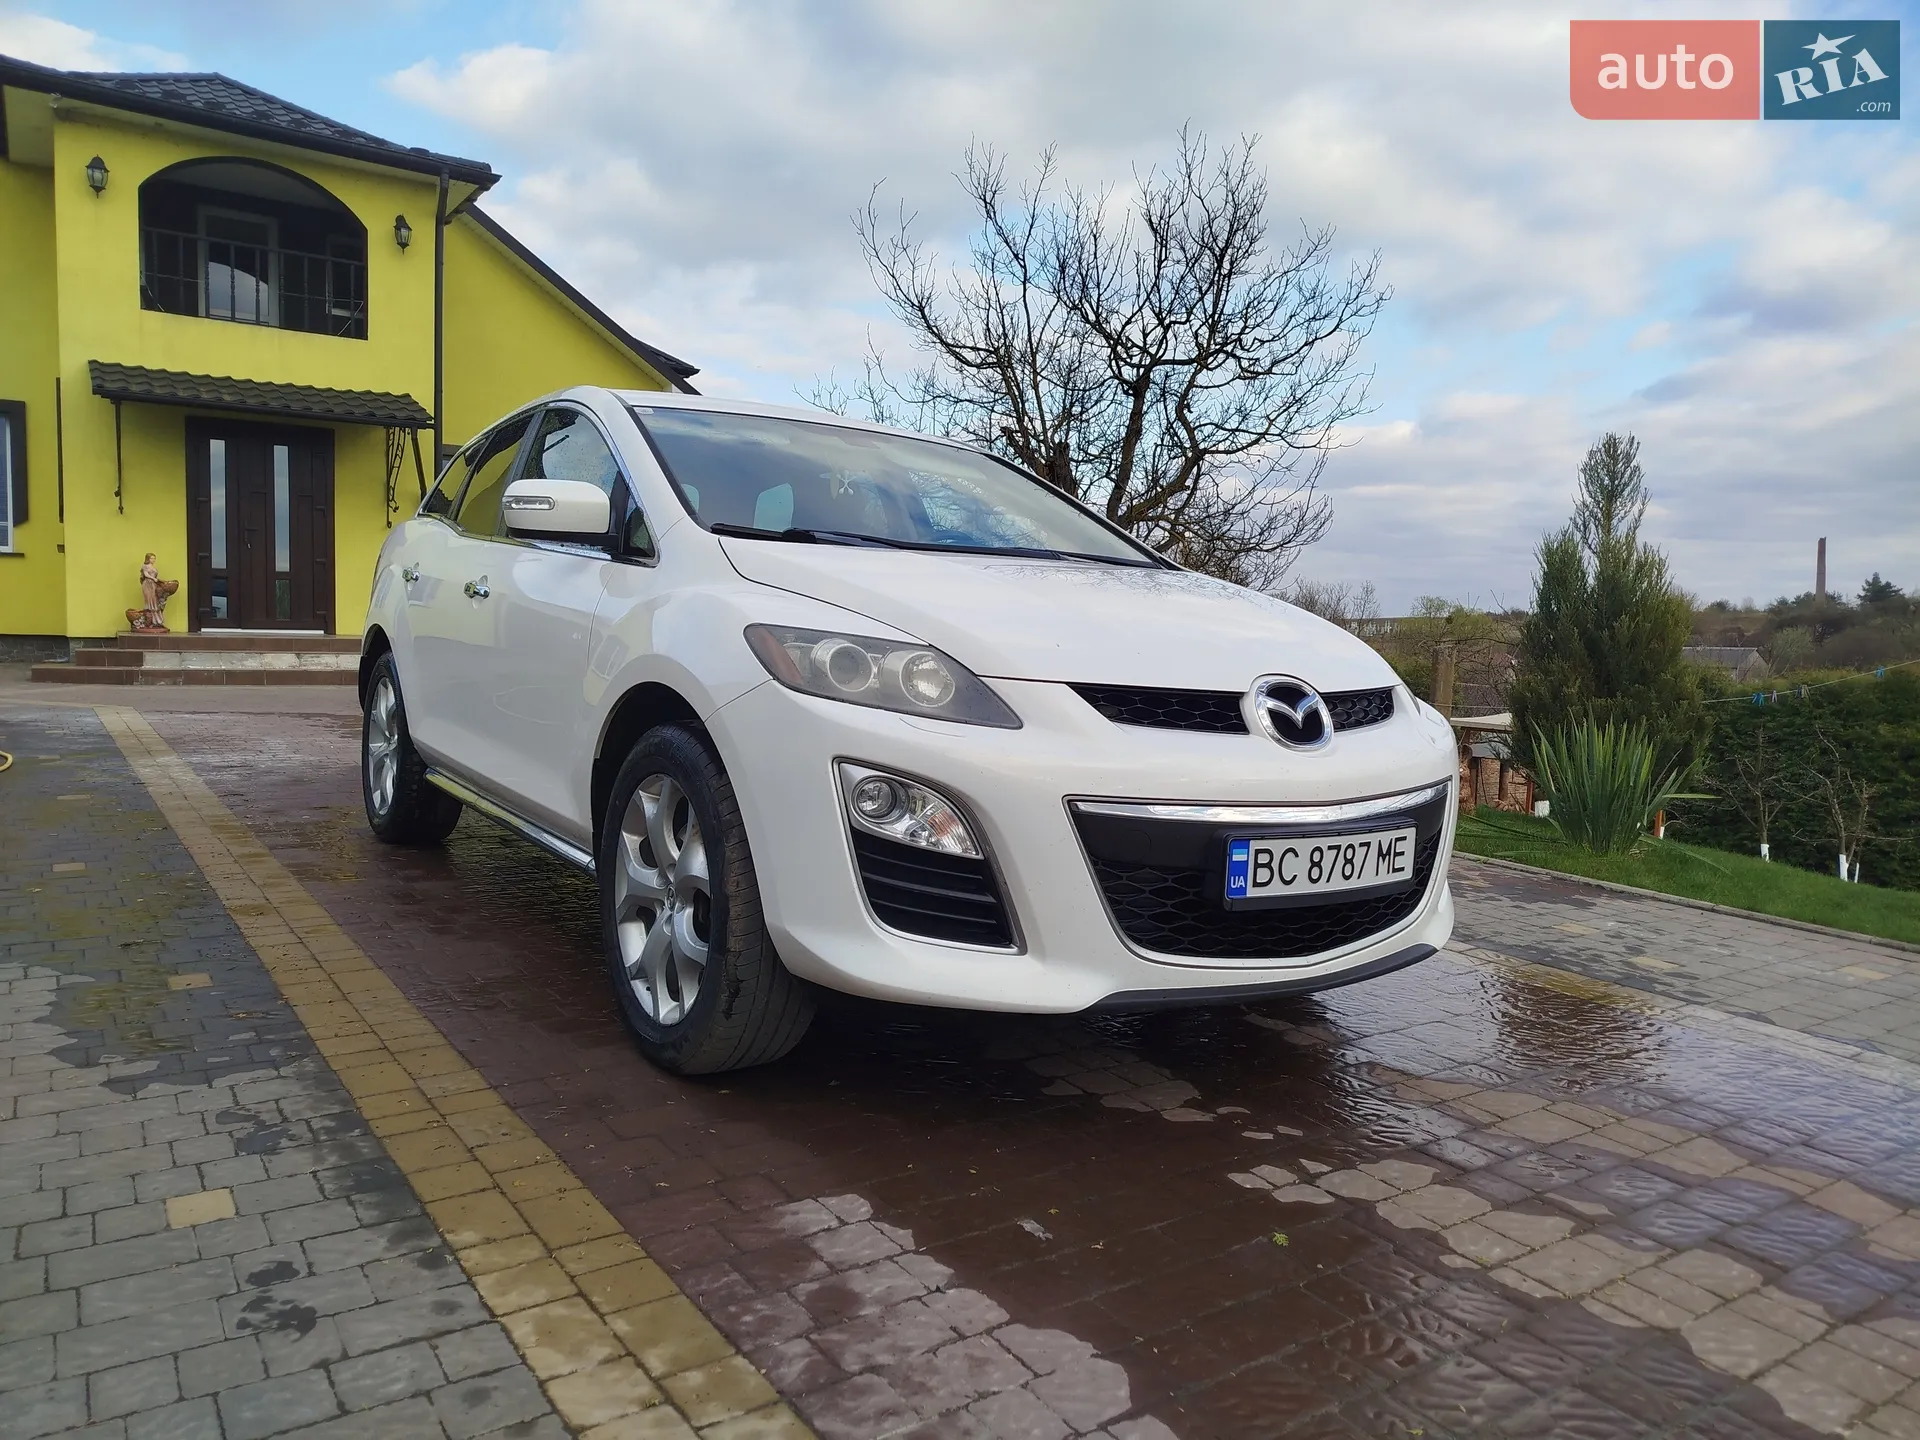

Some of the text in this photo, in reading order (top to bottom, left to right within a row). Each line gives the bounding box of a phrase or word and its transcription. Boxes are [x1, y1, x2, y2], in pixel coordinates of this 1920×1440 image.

[1252, 836, 1408, 888] BC 8787 ME
[1230, 875, 1245, 889] UA
